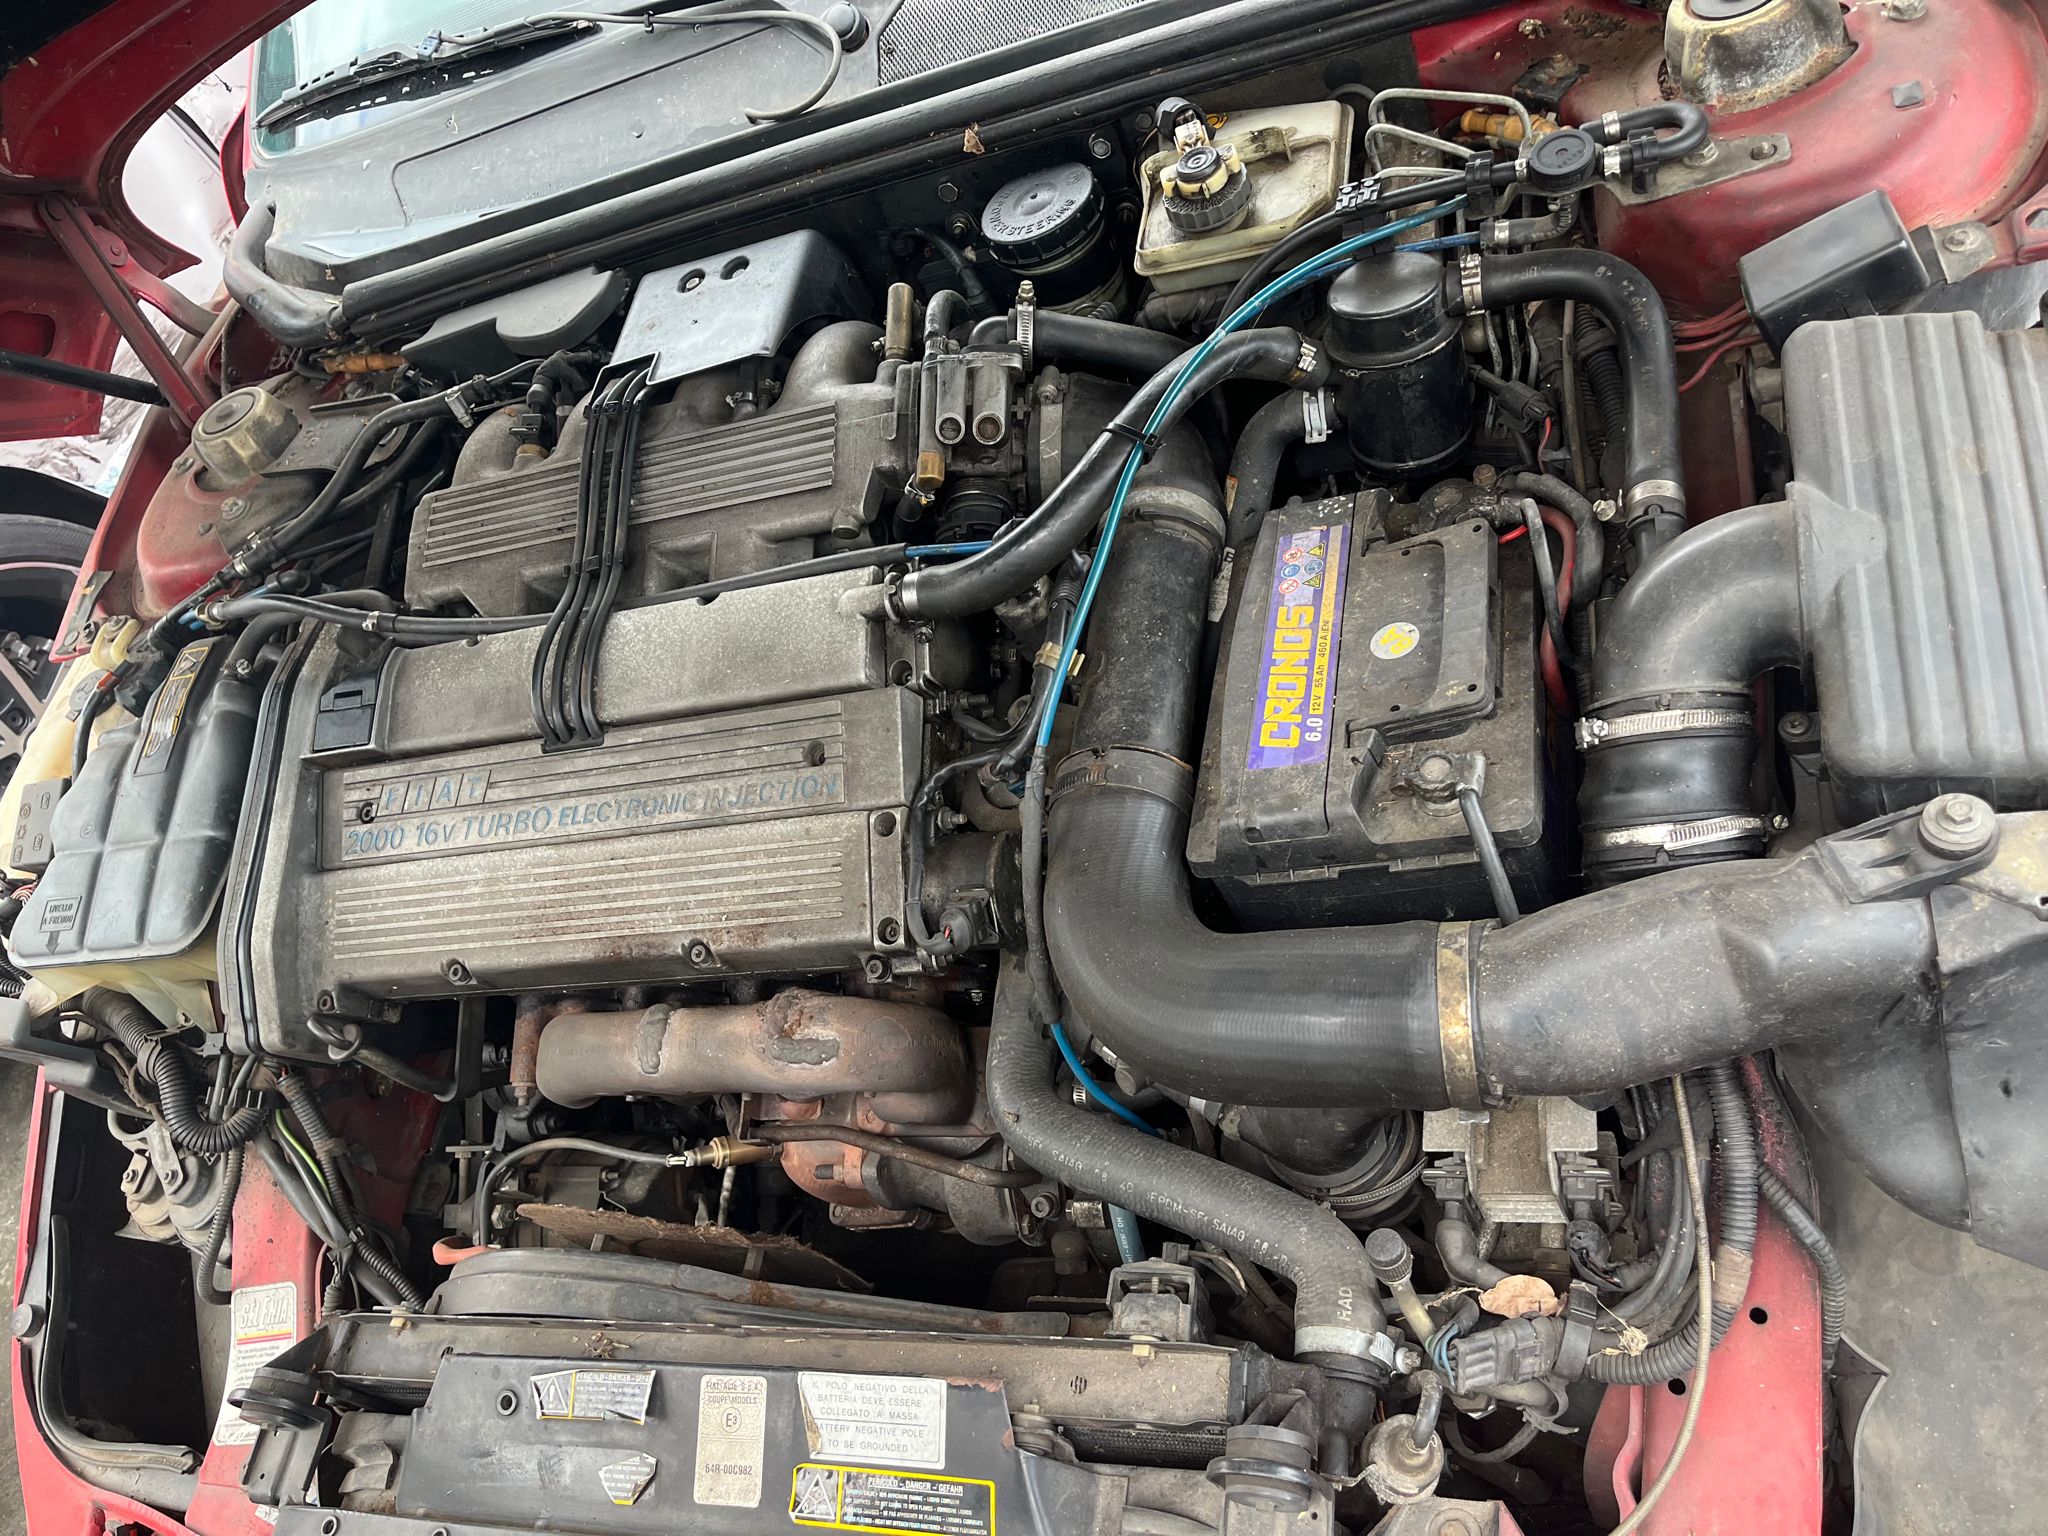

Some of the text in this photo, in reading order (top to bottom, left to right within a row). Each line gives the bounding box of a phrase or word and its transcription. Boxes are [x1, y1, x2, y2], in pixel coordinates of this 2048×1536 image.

[1259, 605, 1315, 749] CRONOS
[1304, 717, 1324, 742] 6.0
[386, 776, 482, 811] FIAT
[346, 826, 405, 856] 2000
[463, 806, 553, 841] TURBO
[558, 789, 698, 828] ELECTRONIC
[703, 772, 841, 811] INJECTION
[825, 1381, 848, 1390] POLO
[854, 1383, 897, 1393] NEGATIVO
[902, 1385, 929, 1395] DELLA
[818, 1393, 922, 1408] BATTERIA DEVE ESSERE
[820, 1406, 870, 1417] COLLEGATO
[889, 1411, 918, 1421] MASSA
[855, 1425, 897, 1436] NEGATIVE
[901, 1428, 924, 1438] POLE
[828, 1438, 908, 1453] TO BE GROUNDED
[905, 1479, 931, 1491] DANGER
[938, 1484, 964, 1495] GEFAHR
